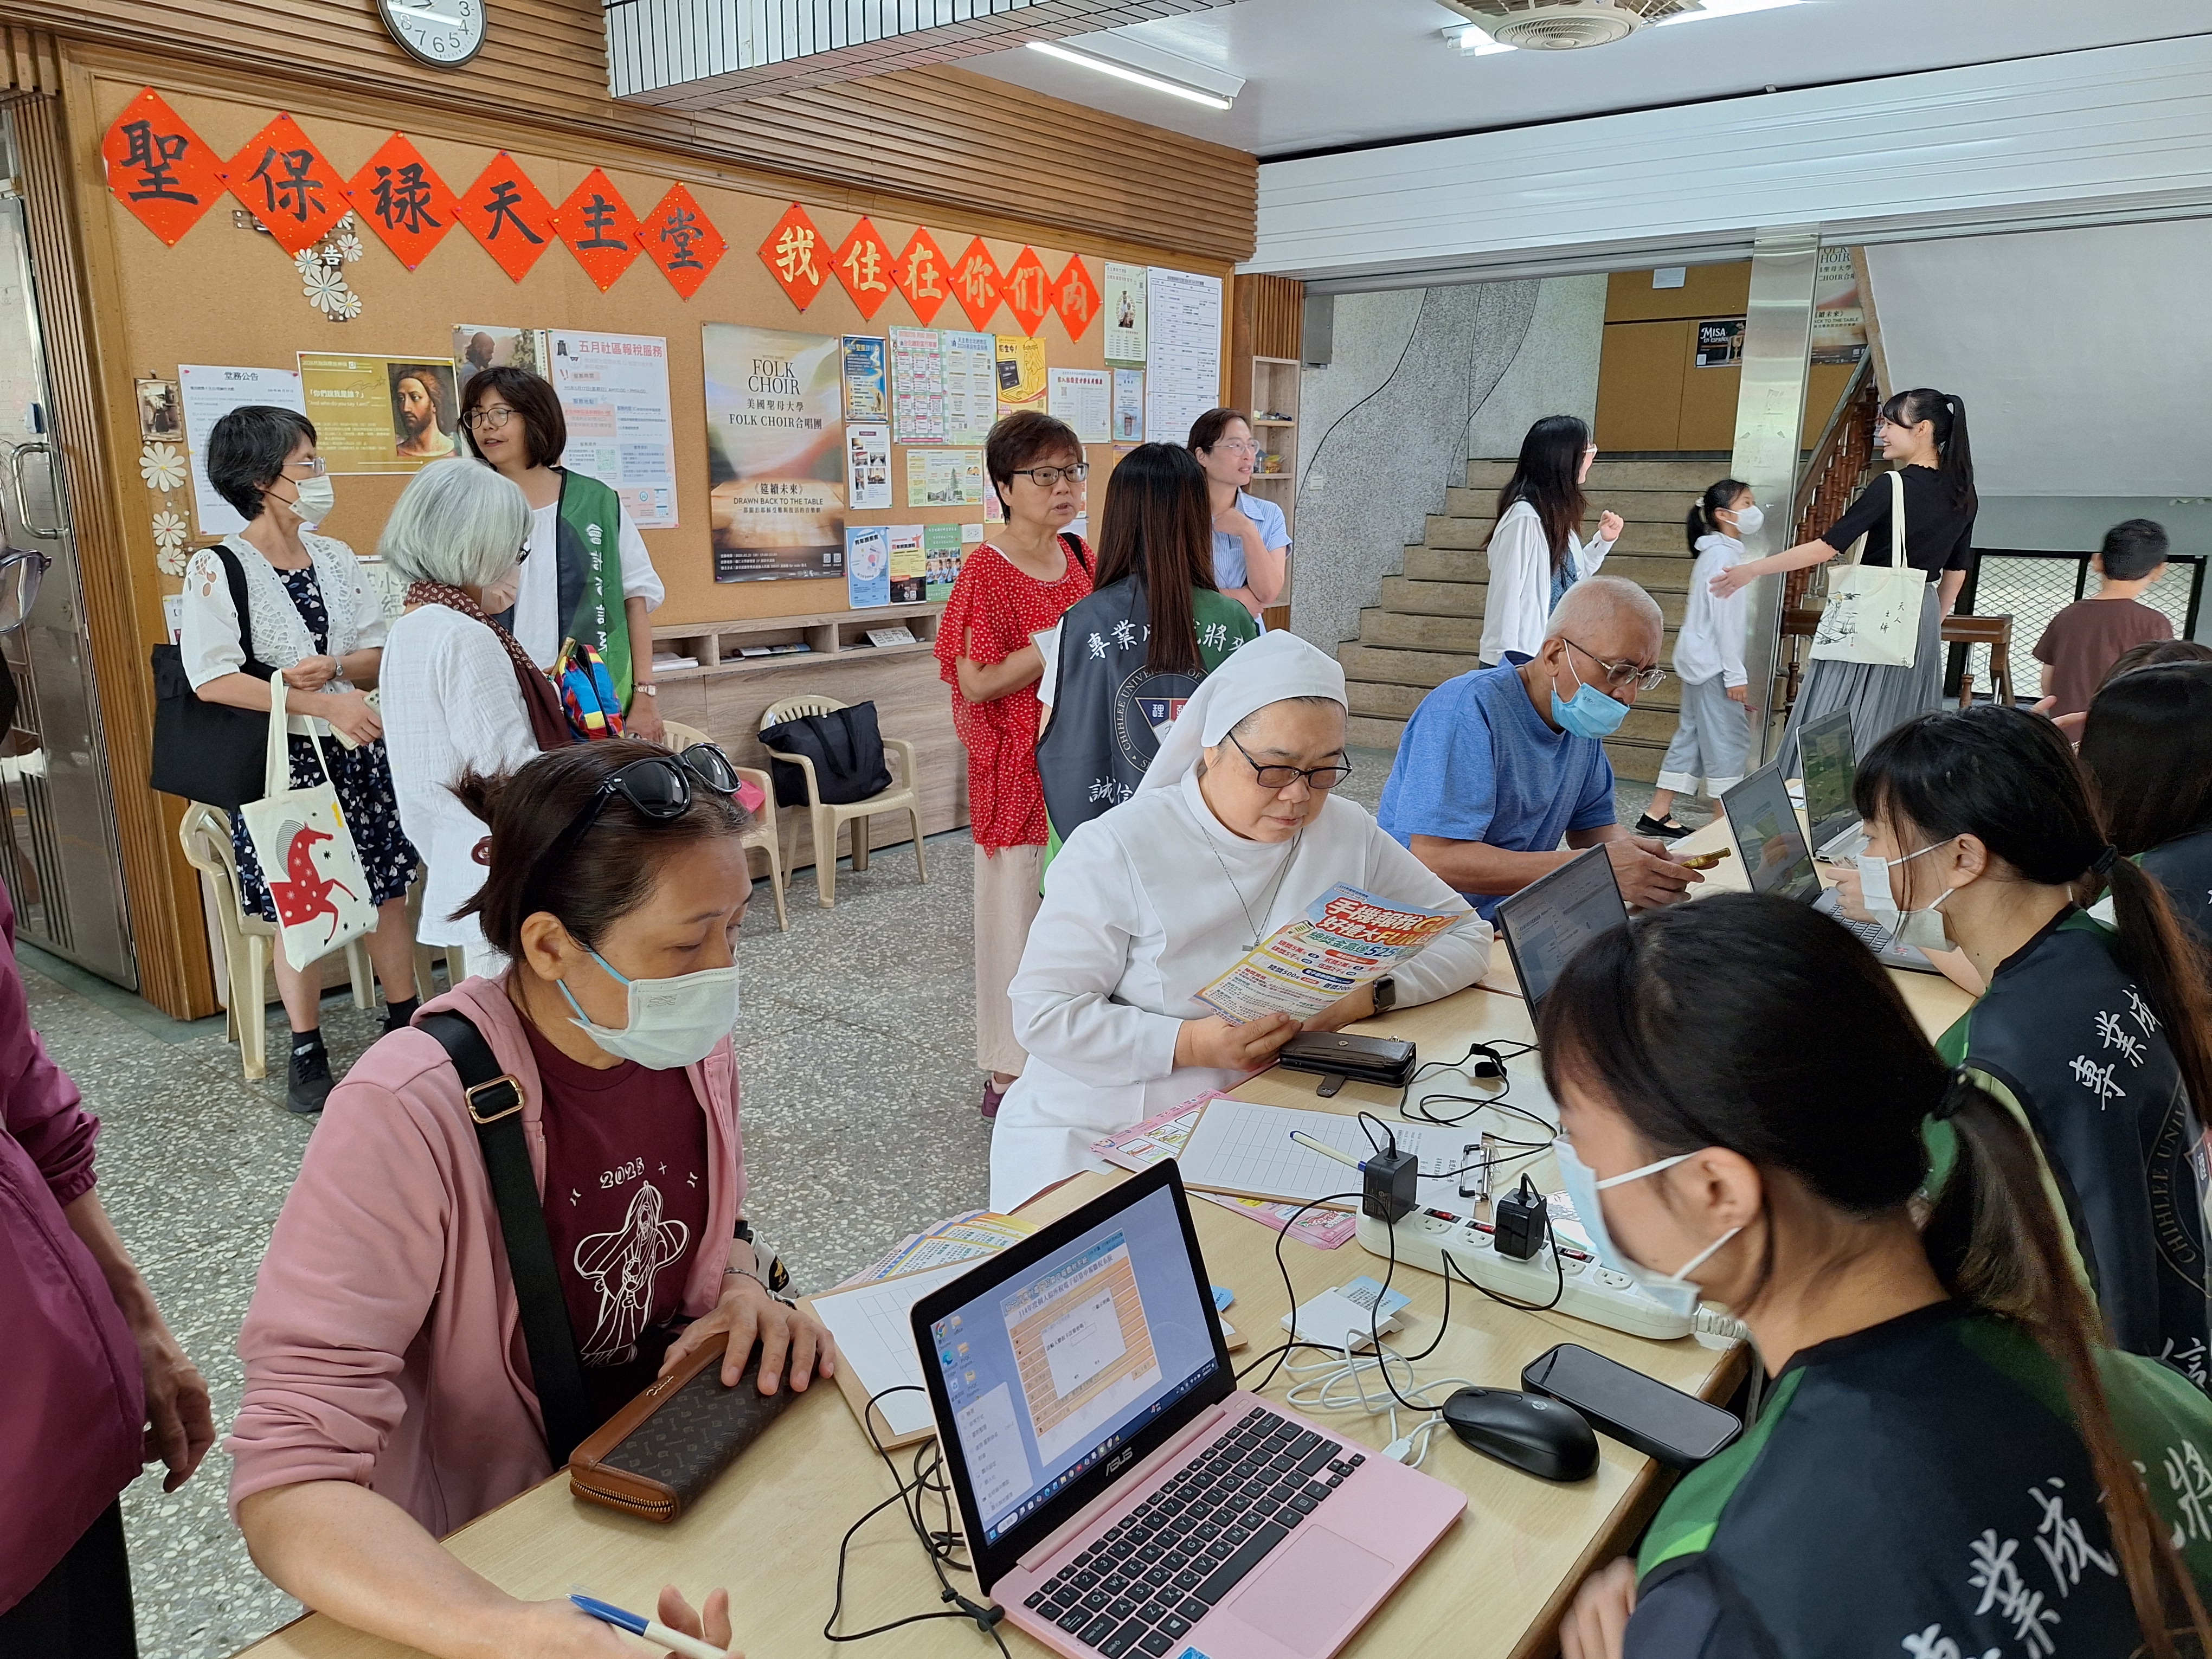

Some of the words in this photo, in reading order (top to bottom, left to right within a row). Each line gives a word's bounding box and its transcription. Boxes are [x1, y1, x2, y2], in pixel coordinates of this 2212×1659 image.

[460, 2, 470, 16] 3
[415, 29, 426, 46] 7
[433, 37, 445, 52] 6
[449, 32, 460, 48] 5
[321, 245, 343, 265] 告
[1820, 253, 1850, 263] HOIR
[1700, 327, 1726, 339] MISA
[579, 340, 663, 358] 五月社區報稅服務
[753, 359, 795, 378] FOLK
[748, 376, 801, 395] CHOIR
[747, 398, 804, 412] 美國聖母大學
[729, 414, 757, 426] FOLK
[1117, 700, 1131, 751] CHIHLEE
[1187, 668, 1203, 679] OF
[1105, 1446, 1134, 1477] ASUS
[1086, 1628, 1096, 1640] caps
[1094, 1622, 1105, 1632] lock
